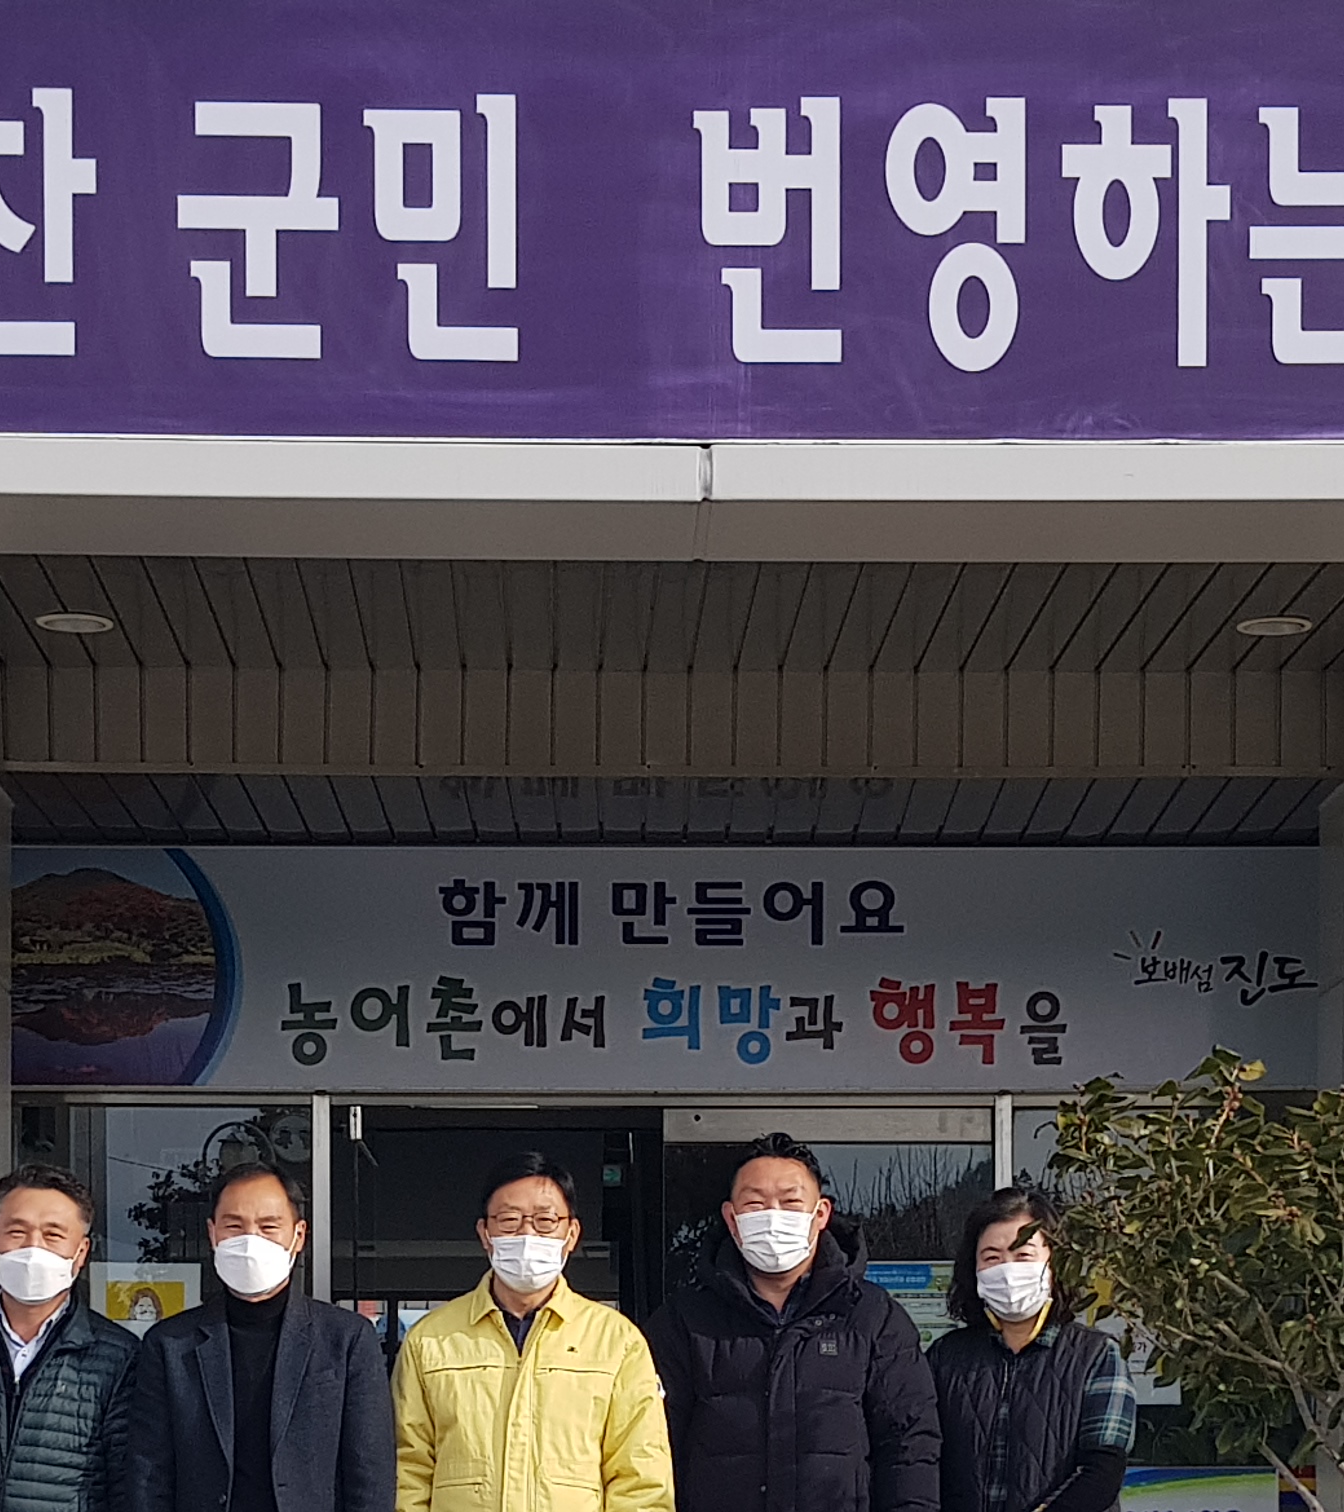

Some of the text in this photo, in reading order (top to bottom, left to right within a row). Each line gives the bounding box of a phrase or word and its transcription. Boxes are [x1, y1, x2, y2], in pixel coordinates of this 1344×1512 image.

[177, 93, 519, 361] 군민
[438, 878, 905, 947] 함께 만들어요
[1134, 951, 1319, 1005] 보배섬 진도
[281, 975, 1068, 1066] 농어촌에서 희망과 행복을
